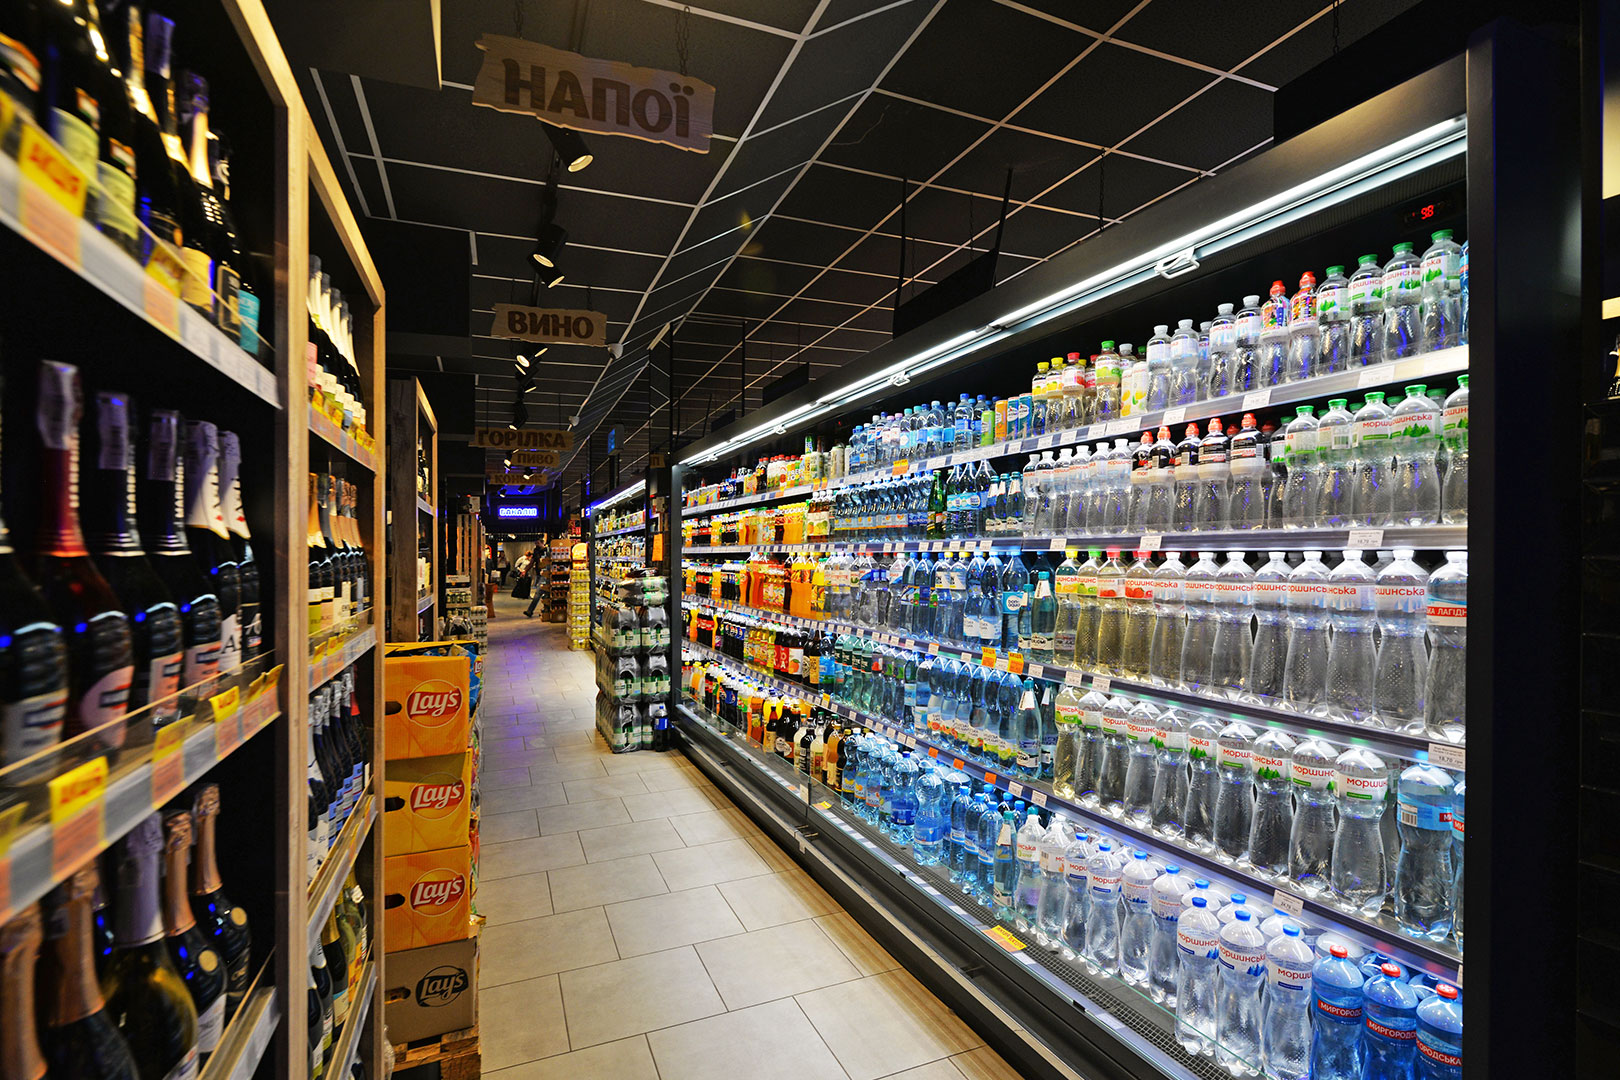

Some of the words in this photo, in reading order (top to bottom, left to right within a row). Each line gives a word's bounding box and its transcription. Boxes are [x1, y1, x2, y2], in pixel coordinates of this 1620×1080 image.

[502, 58, 694, 138] НАПОЇ
[507, 310, 594, 339] ВИНО
[478, 429, 567, 449] ГОРІЛКА
[516, 453, 554, 465] ПИВО
[410, 690, 460, 717] Lay's
[413, 781, 462, 809] Lay's
[413, 877, 462, 905] Lay's
[420, 973, 464, 999] Lay's
